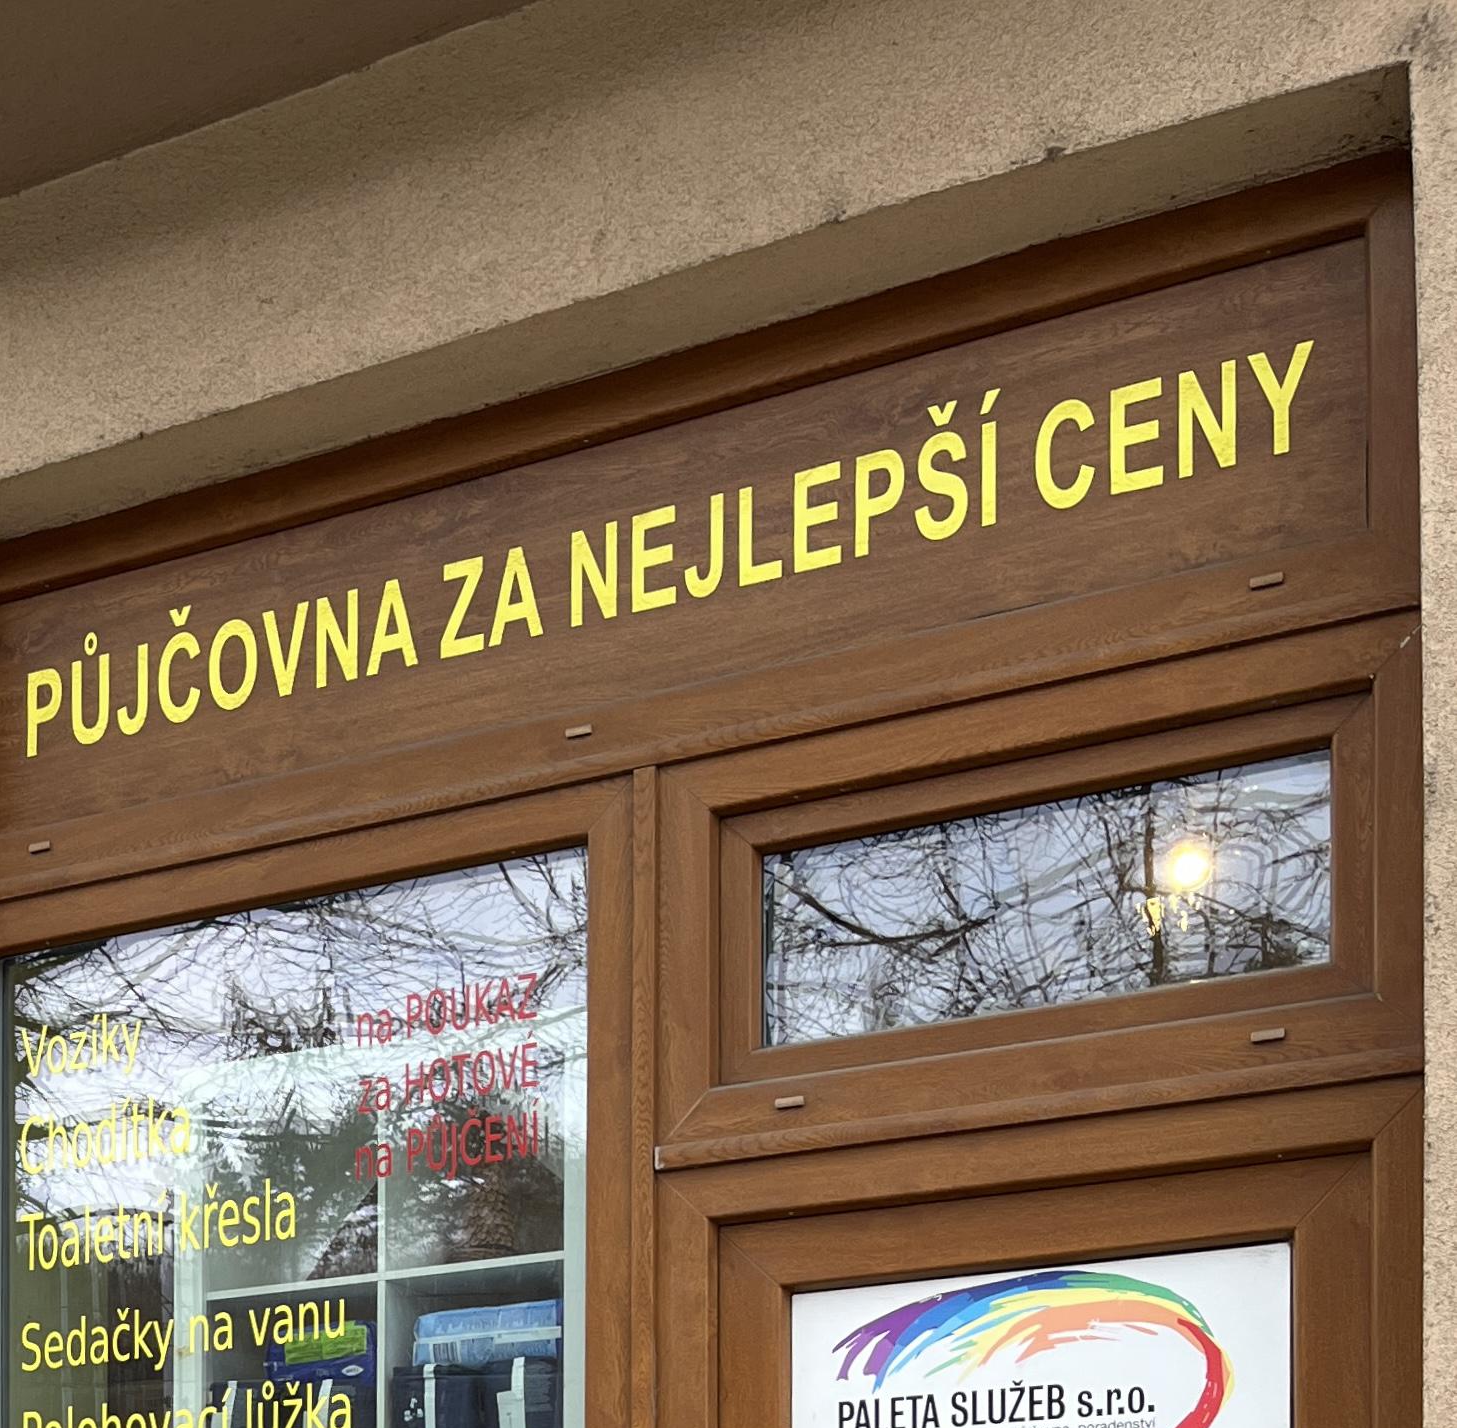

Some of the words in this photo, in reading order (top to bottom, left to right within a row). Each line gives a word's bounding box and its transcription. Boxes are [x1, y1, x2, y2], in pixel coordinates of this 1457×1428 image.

[25, 578, 418, 758] PŮJČOVNA
[440, 545, 544, 660] ZA
[570, 388, 1002, 628] NEJLEPŠÍ
[1035, 340, 1315, 510] CENY
[21, 1013, 142, 1078] Vozíky
[357, 1008, 393, 1047] na
[406, 972, 539, 1039] POUKAZ
[357, 1076, 391, 1114] za
[405, 1030, 540, 1105] HOTOVÉ
[19, 1097, 191, 1175] Chodítka
[355, 1142, 392, 1183] na
[406, 1097, 540, 1181] PŮJČENÍ
[20, 1191, 170, 1271] Toaletní
[179, 1178, 297, 1251] křesla
[20, 1306, 175, 1372] Sedačky
[188, 1310, 233, 1354] na
[248, 1298, 346, 1348] vanu
[950, 1380, 1066, 1427] SLUŽEB
[1077, 1385, 1156, 1418] s.r.o.
